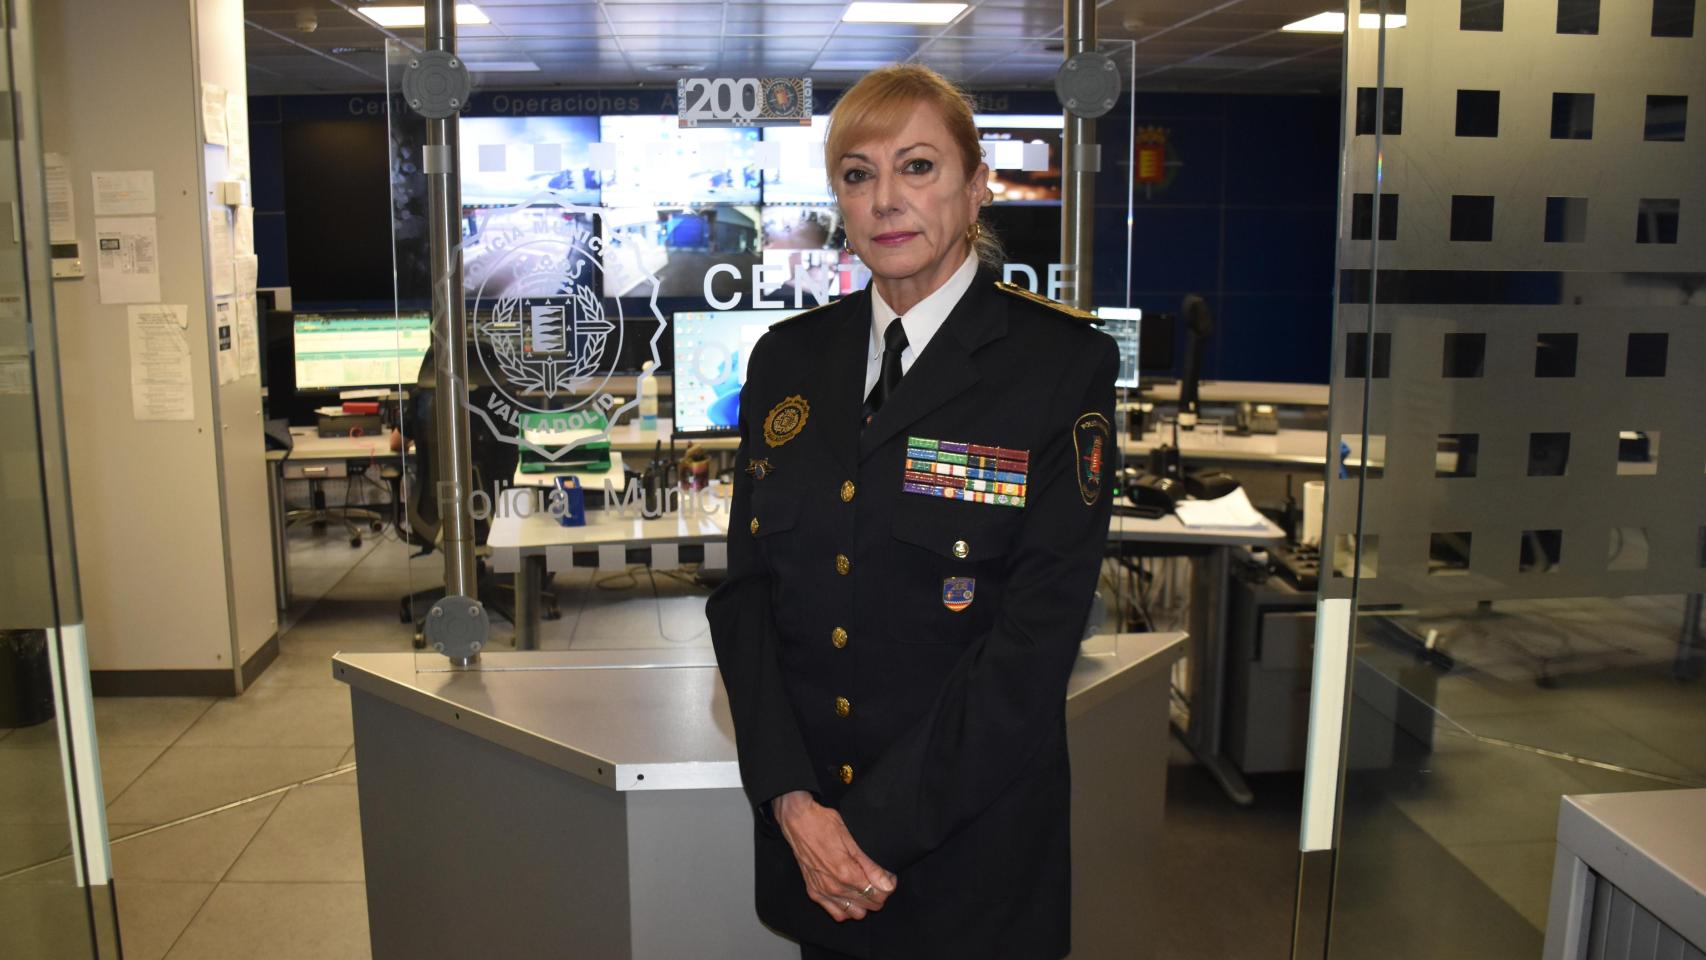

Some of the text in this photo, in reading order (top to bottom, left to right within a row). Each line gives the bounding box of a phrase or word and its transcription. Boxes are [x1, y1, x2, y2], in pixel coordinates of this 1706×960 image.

[492, 94, 640, 115] Operaciones
[686, 78, 763, 119] 200
[703, 263, 1079, 310] CENT DE
[486, 392, 615, 433] VALLADOLID
[603, 477, 729, 518] Munici
